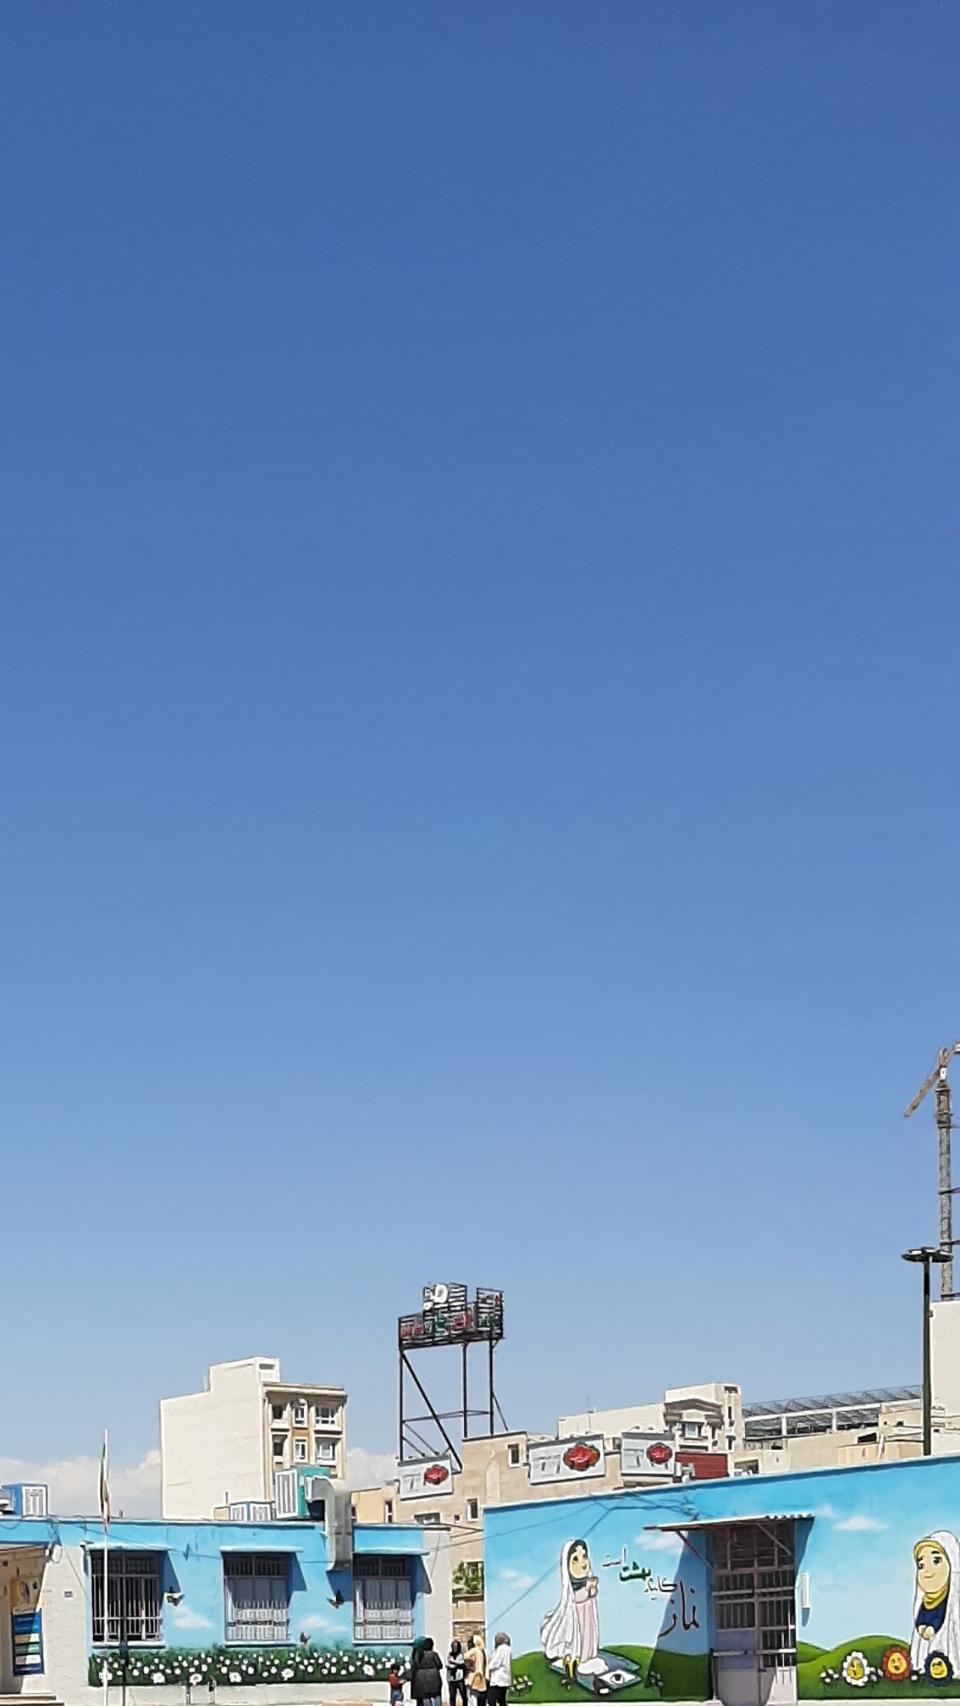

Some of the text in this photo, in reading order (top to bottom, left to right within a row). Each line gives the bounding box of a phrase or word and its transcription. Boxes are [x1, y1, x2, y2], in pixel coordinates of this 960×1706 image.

[602, 1547, 628, 1568] است
[619, 1561, 651, 1582] بهشت
[657, 1580, 700, 1639] نماز
